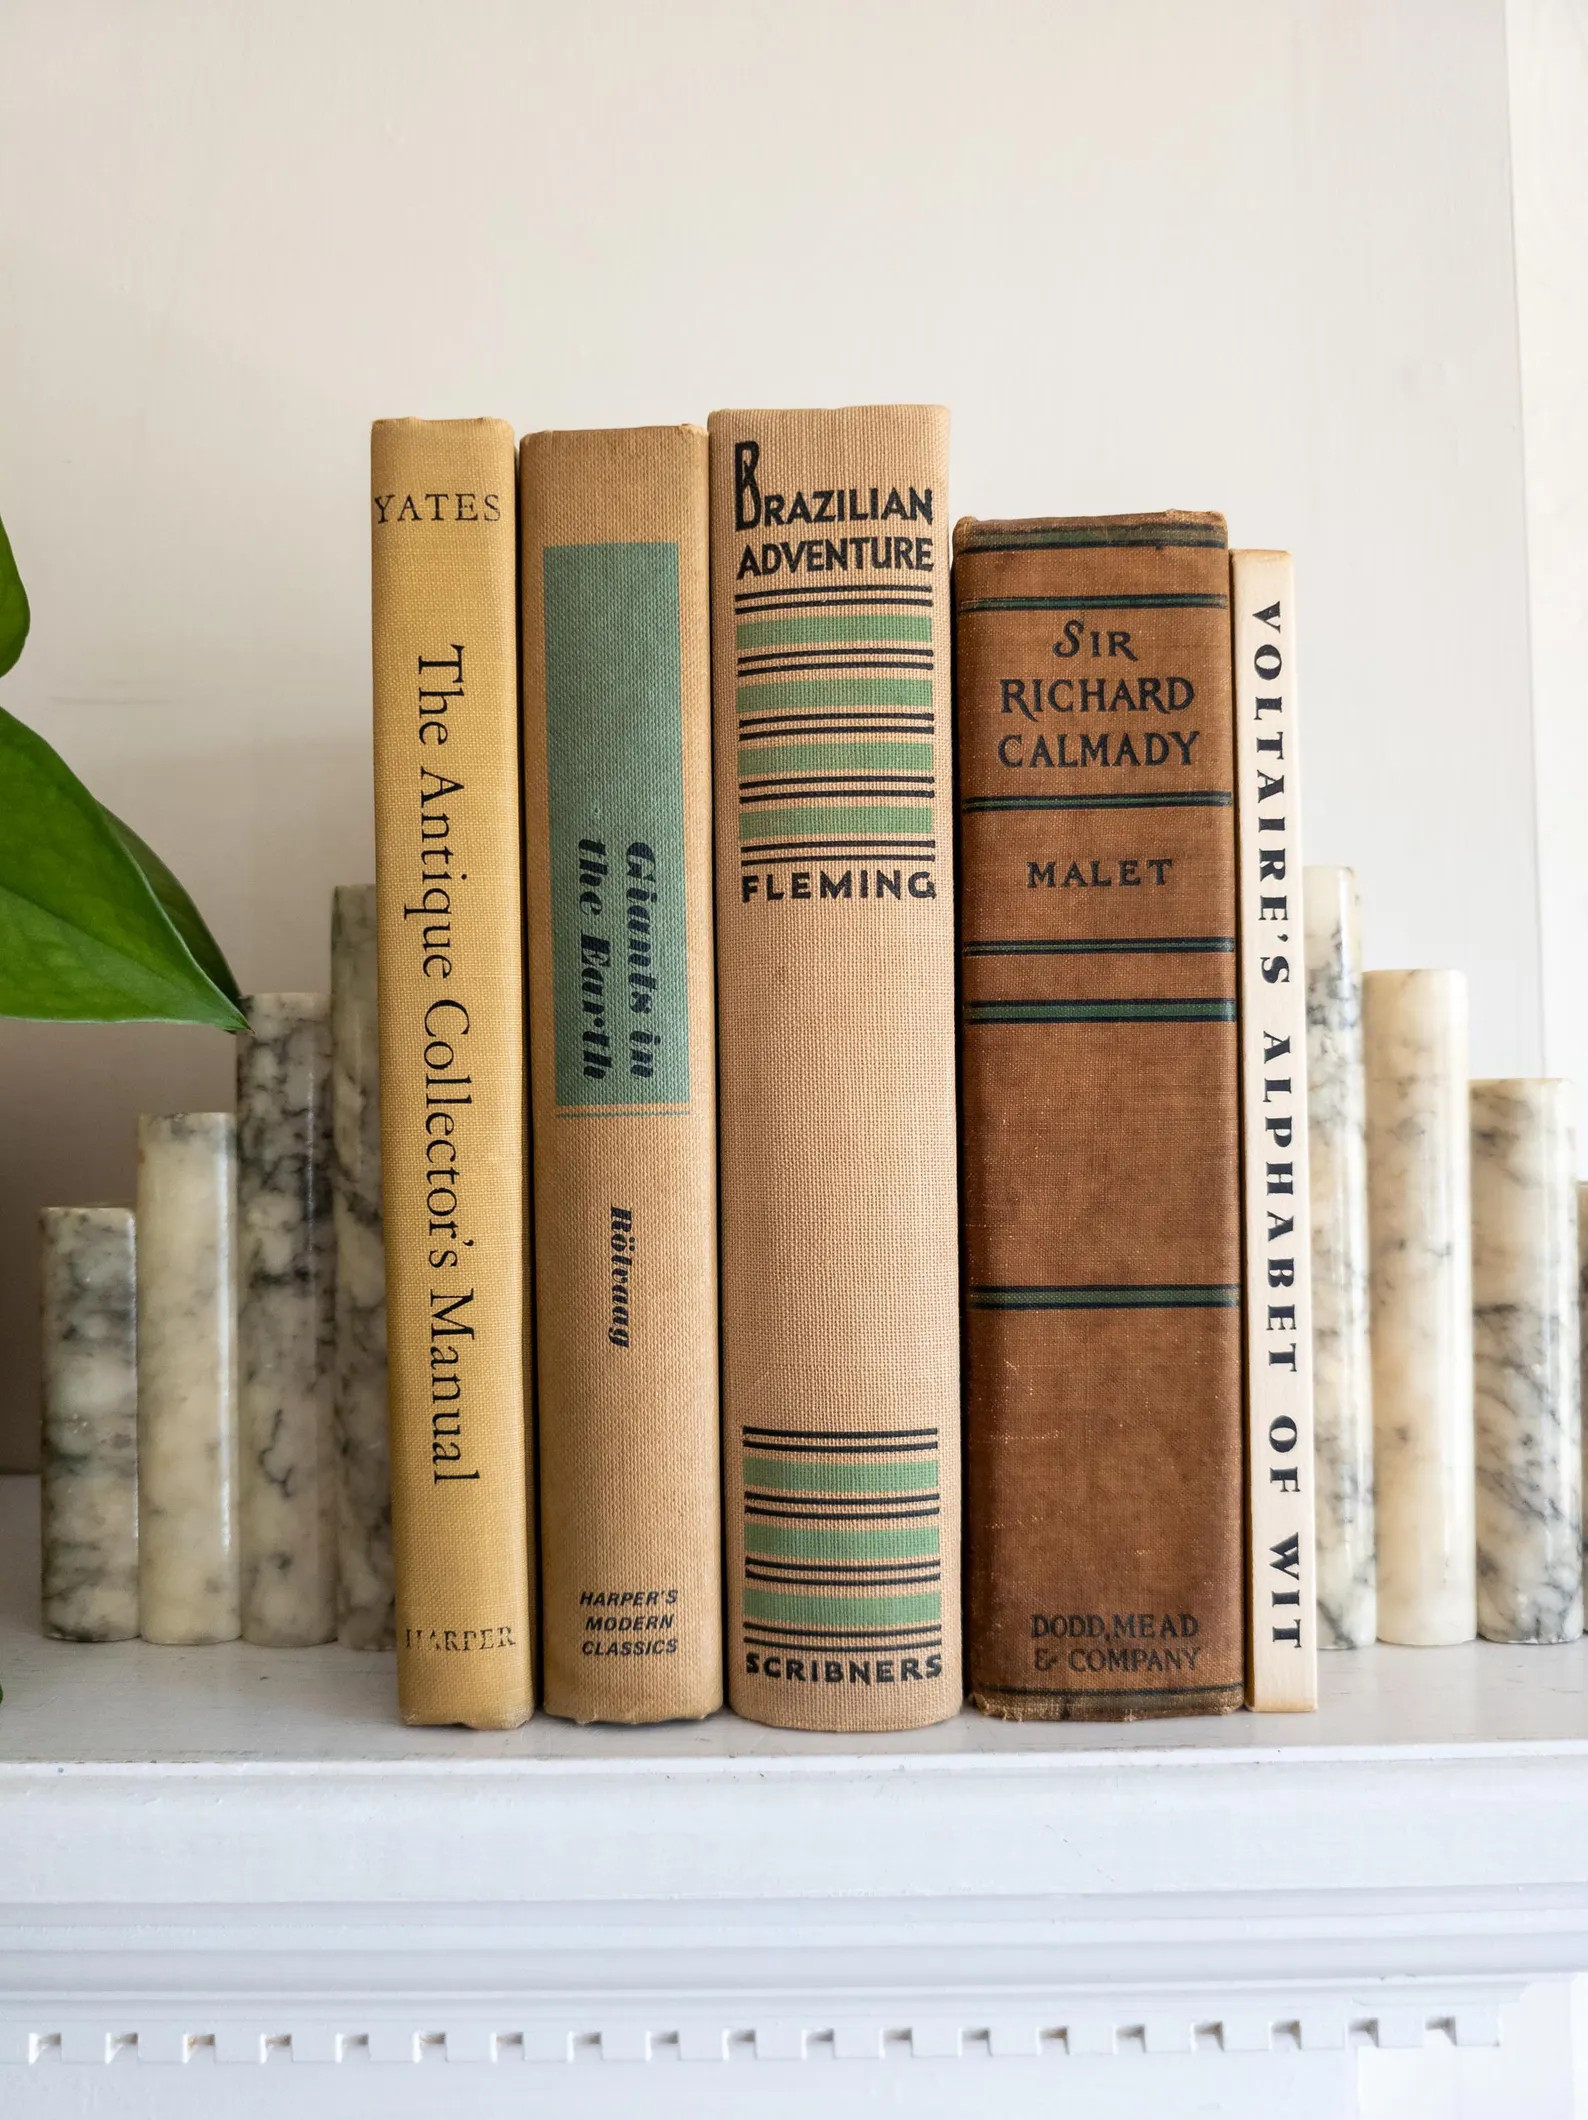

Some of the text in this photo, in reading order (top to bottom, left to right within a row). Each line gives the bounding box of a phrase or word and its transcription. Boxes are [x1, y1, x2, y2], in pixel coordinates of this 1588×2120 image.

[735, 440, 933, 532] BRAZILIAN
[374, 493, 501, 523] YATES
[736, 536, 934, 580] ADVENTURE
[1052, 620, 1138, 662] SIR
[1000, 676, 1196, 722] RICHARD
[998, 730, 1200, 769] CALMADY
[741, 869, 936, 903] FLEMING
[1027, 858, 1172, 888] MALET
[578, 838, 612, 1080] the Earth
[626, 842, 662, 1079] Giants in
[404, 643, 481, 1484] The Antique Collector's Manual
[1252, 600, 1302, 1649] VOLTAIRE'S ALPHABET OF WIT
[579, 1589, 679, 1606] HARPER'S
[585, 1613, 675, 1632] MODERN
[581, 1638, 679, 1656] CLASSICS
[1034, 1646, 1201, 1673] & COMPANY
[745, 1652, 943, 1686] SCRIBNERS
